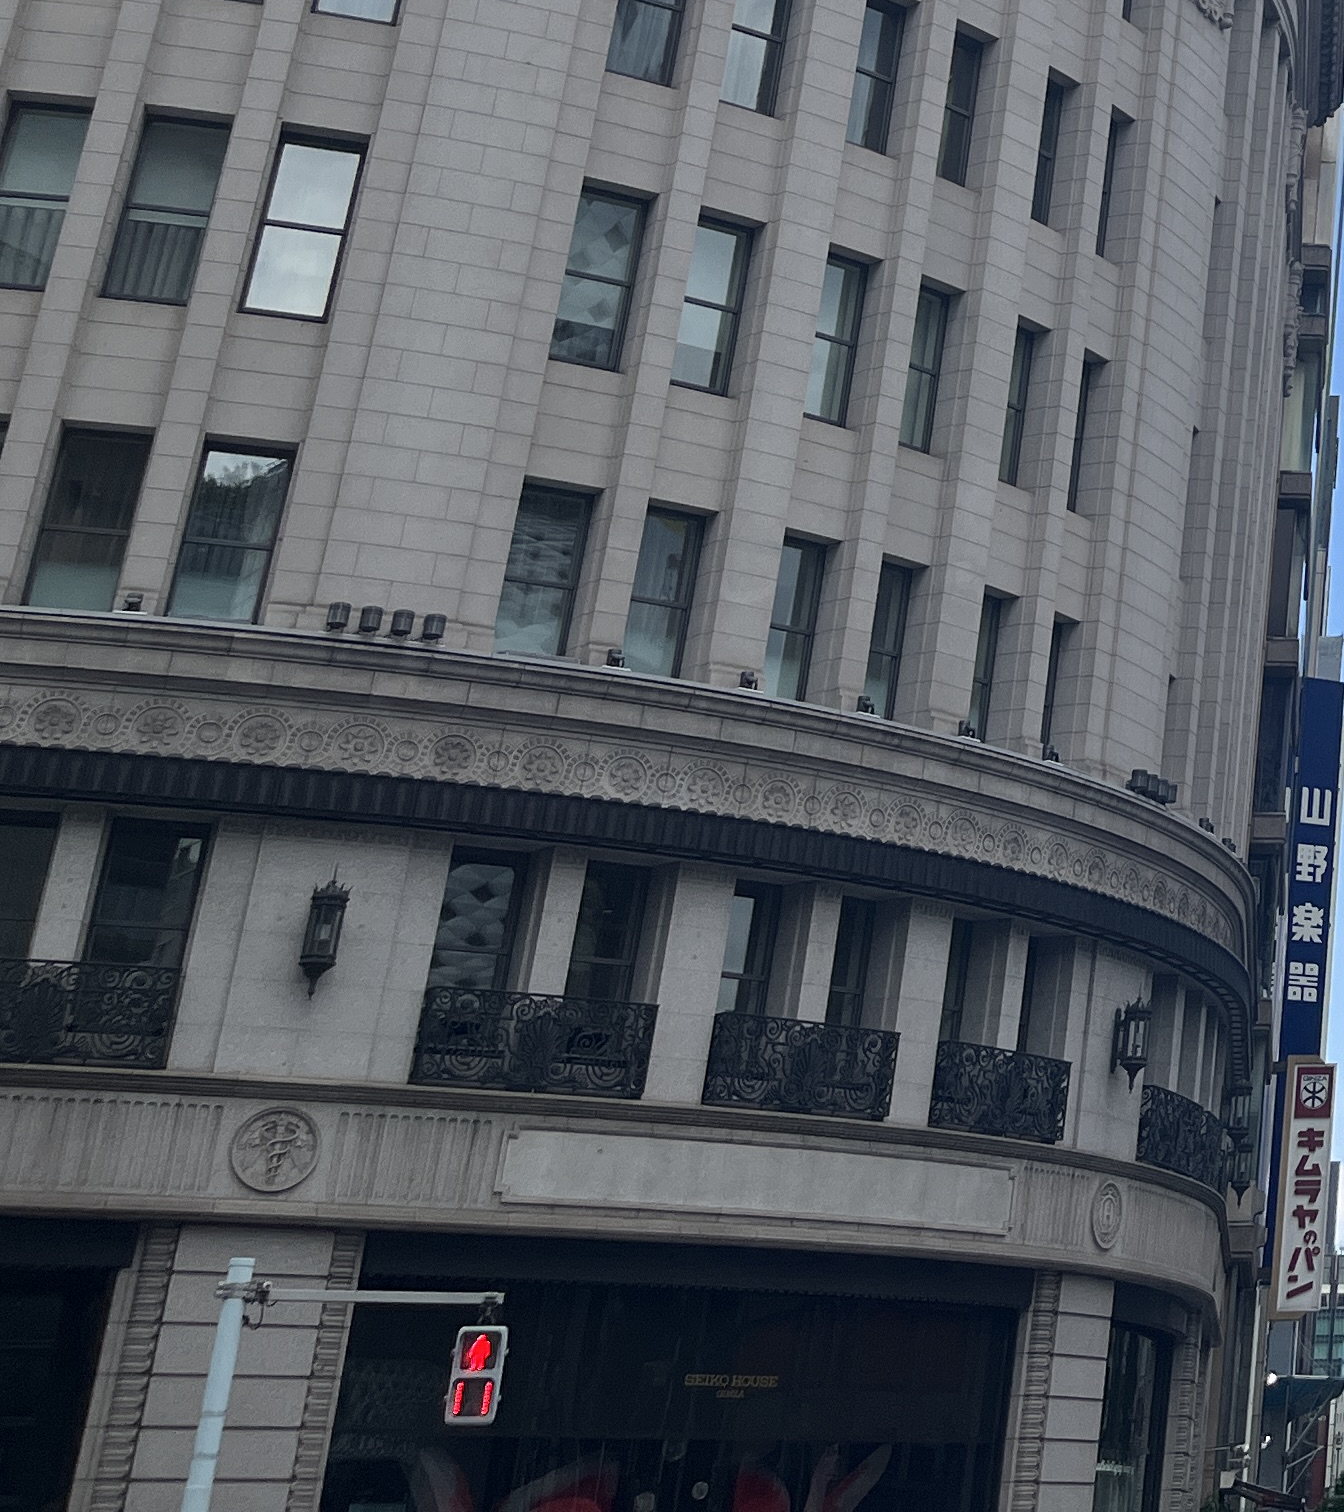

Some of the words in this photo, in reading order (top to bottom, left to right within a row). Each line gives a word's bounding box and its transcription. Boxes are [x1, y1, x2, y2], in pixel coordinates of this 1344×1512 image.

[1287, 786, 1332, 1003] 山野楽器
[1286, 1128, 1326, 1300] キムラヤのパン
[684, 1374, 729, 1386] SEIKO
[731, 1374, 779, 1387] HOUSE
